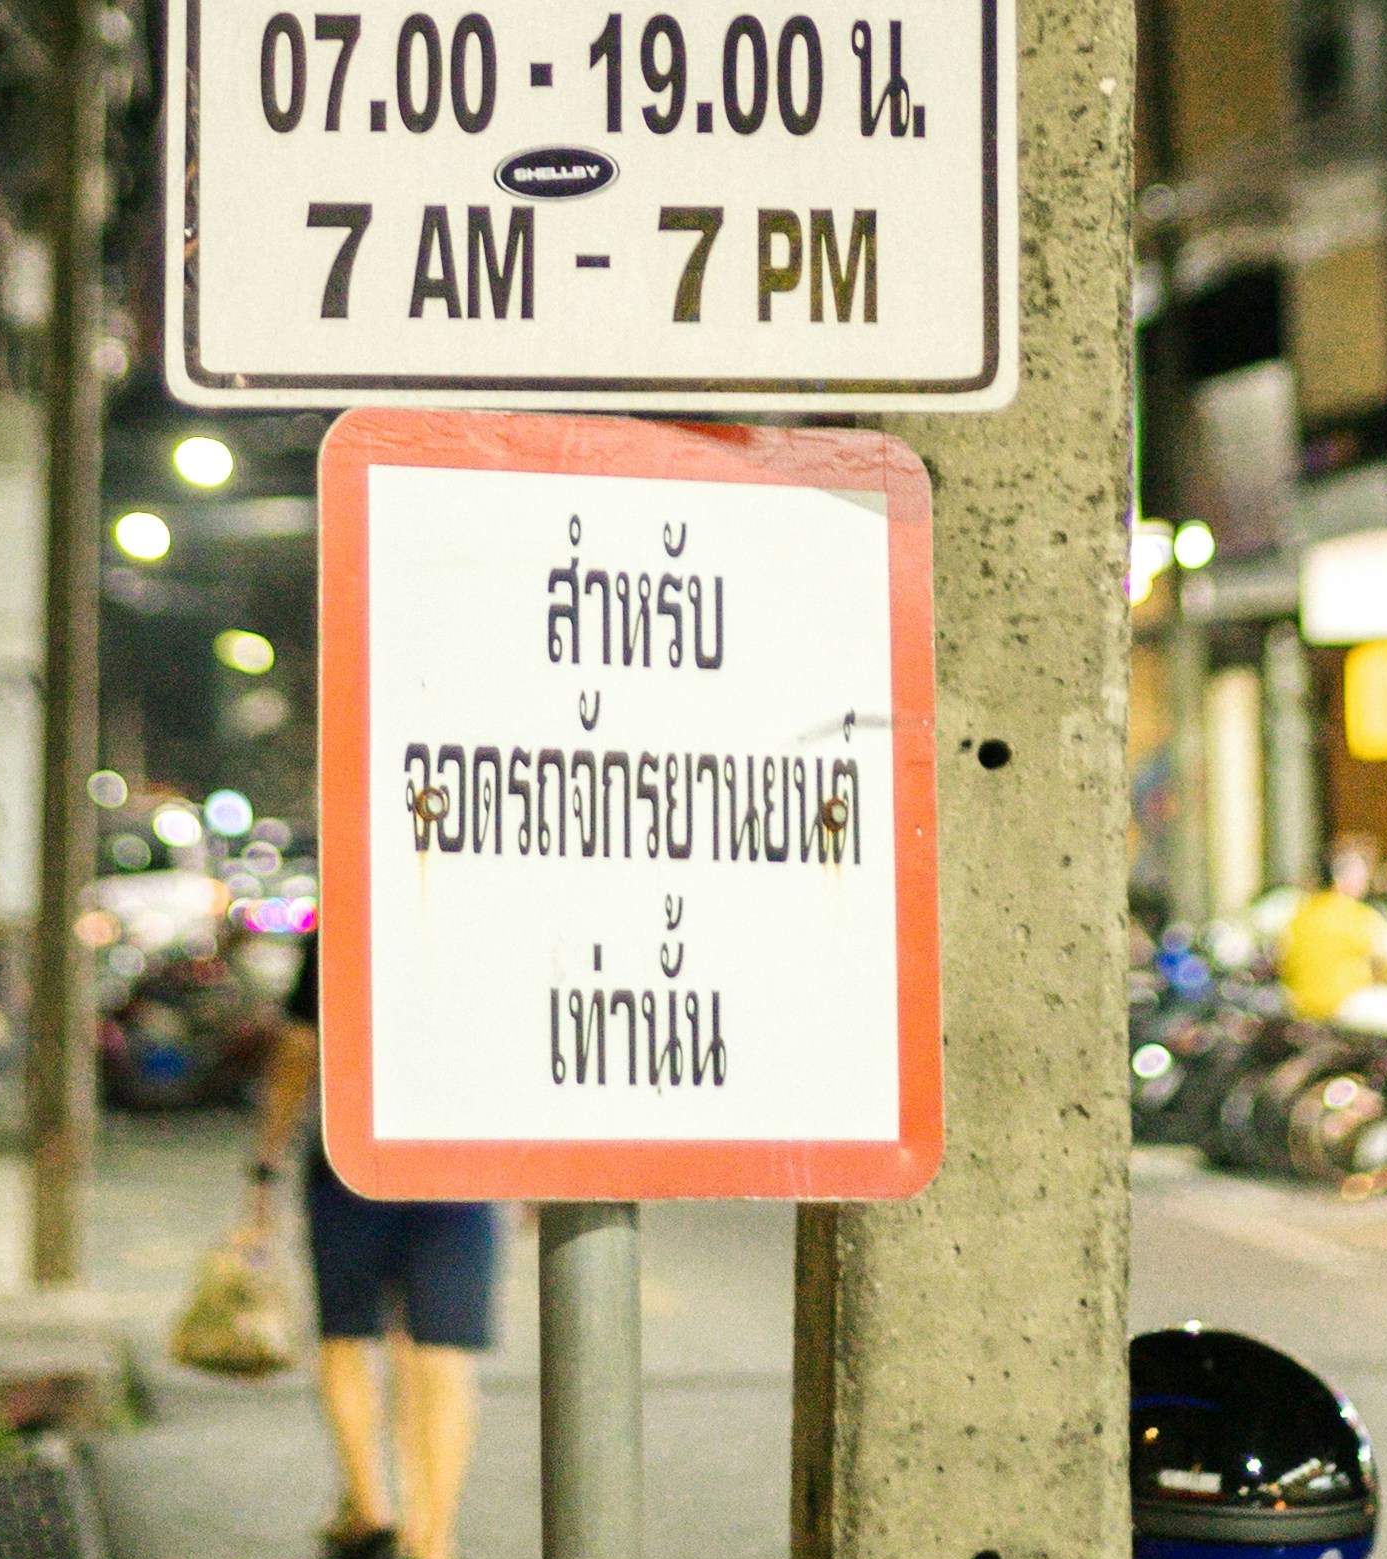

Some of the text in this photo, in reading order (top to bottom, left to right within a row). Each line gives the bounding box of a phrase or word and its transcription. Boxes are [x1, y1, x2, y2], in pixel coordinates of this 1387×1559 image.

[260, 12, 926, 138] 07.00 - 19.00 น.
[306, 202, 878, 323] 7 AM - 7 PM
[547, 514, 723, 670] สำหรับ
[404, 690, 861, 865] จอดรถจักรยานยนต์
[550, 893, 726, 1087] เท่านั้น
